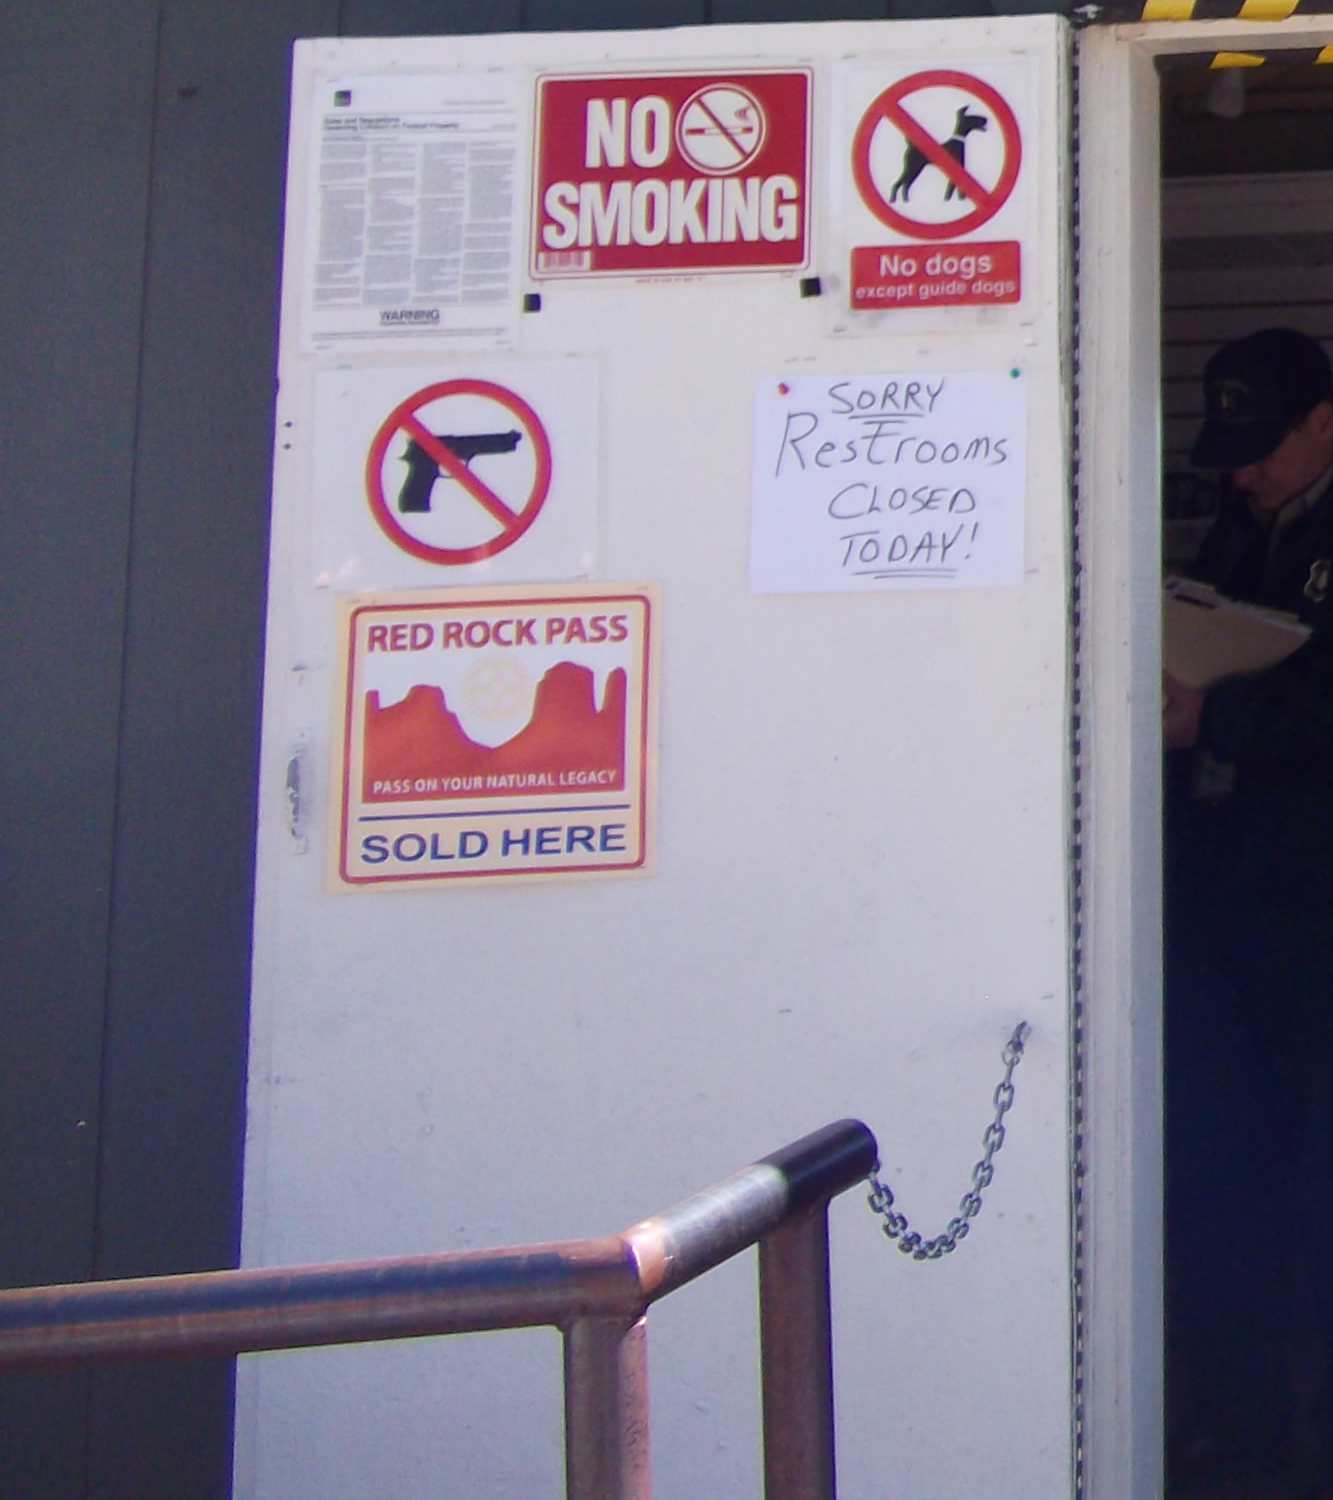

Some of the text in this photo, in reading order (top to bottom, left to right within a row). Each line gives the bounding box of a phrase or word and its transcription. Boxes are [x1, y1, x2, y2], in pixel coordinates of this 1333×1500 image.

[585, 95, 670, 168] NO
[542, 174, 797, 249] SMOKING
[879, 253, 992, 280] No dogs
[855, 279, 1015, 300] except guide dogs
[828, 378, 945, 413] SORRY
[775, 411, 1007, 477] Restrooms
[828, 483, 976, 519] CLOSED
[840, 522, 978, 567] TODAY!
[367, 615, 628, 652] RED ROCK PASS
[373, 770, 616, 794] PASS ON YOUR NATURAL LEGACY
[360, 824, 626, 863] SOLD HERE
